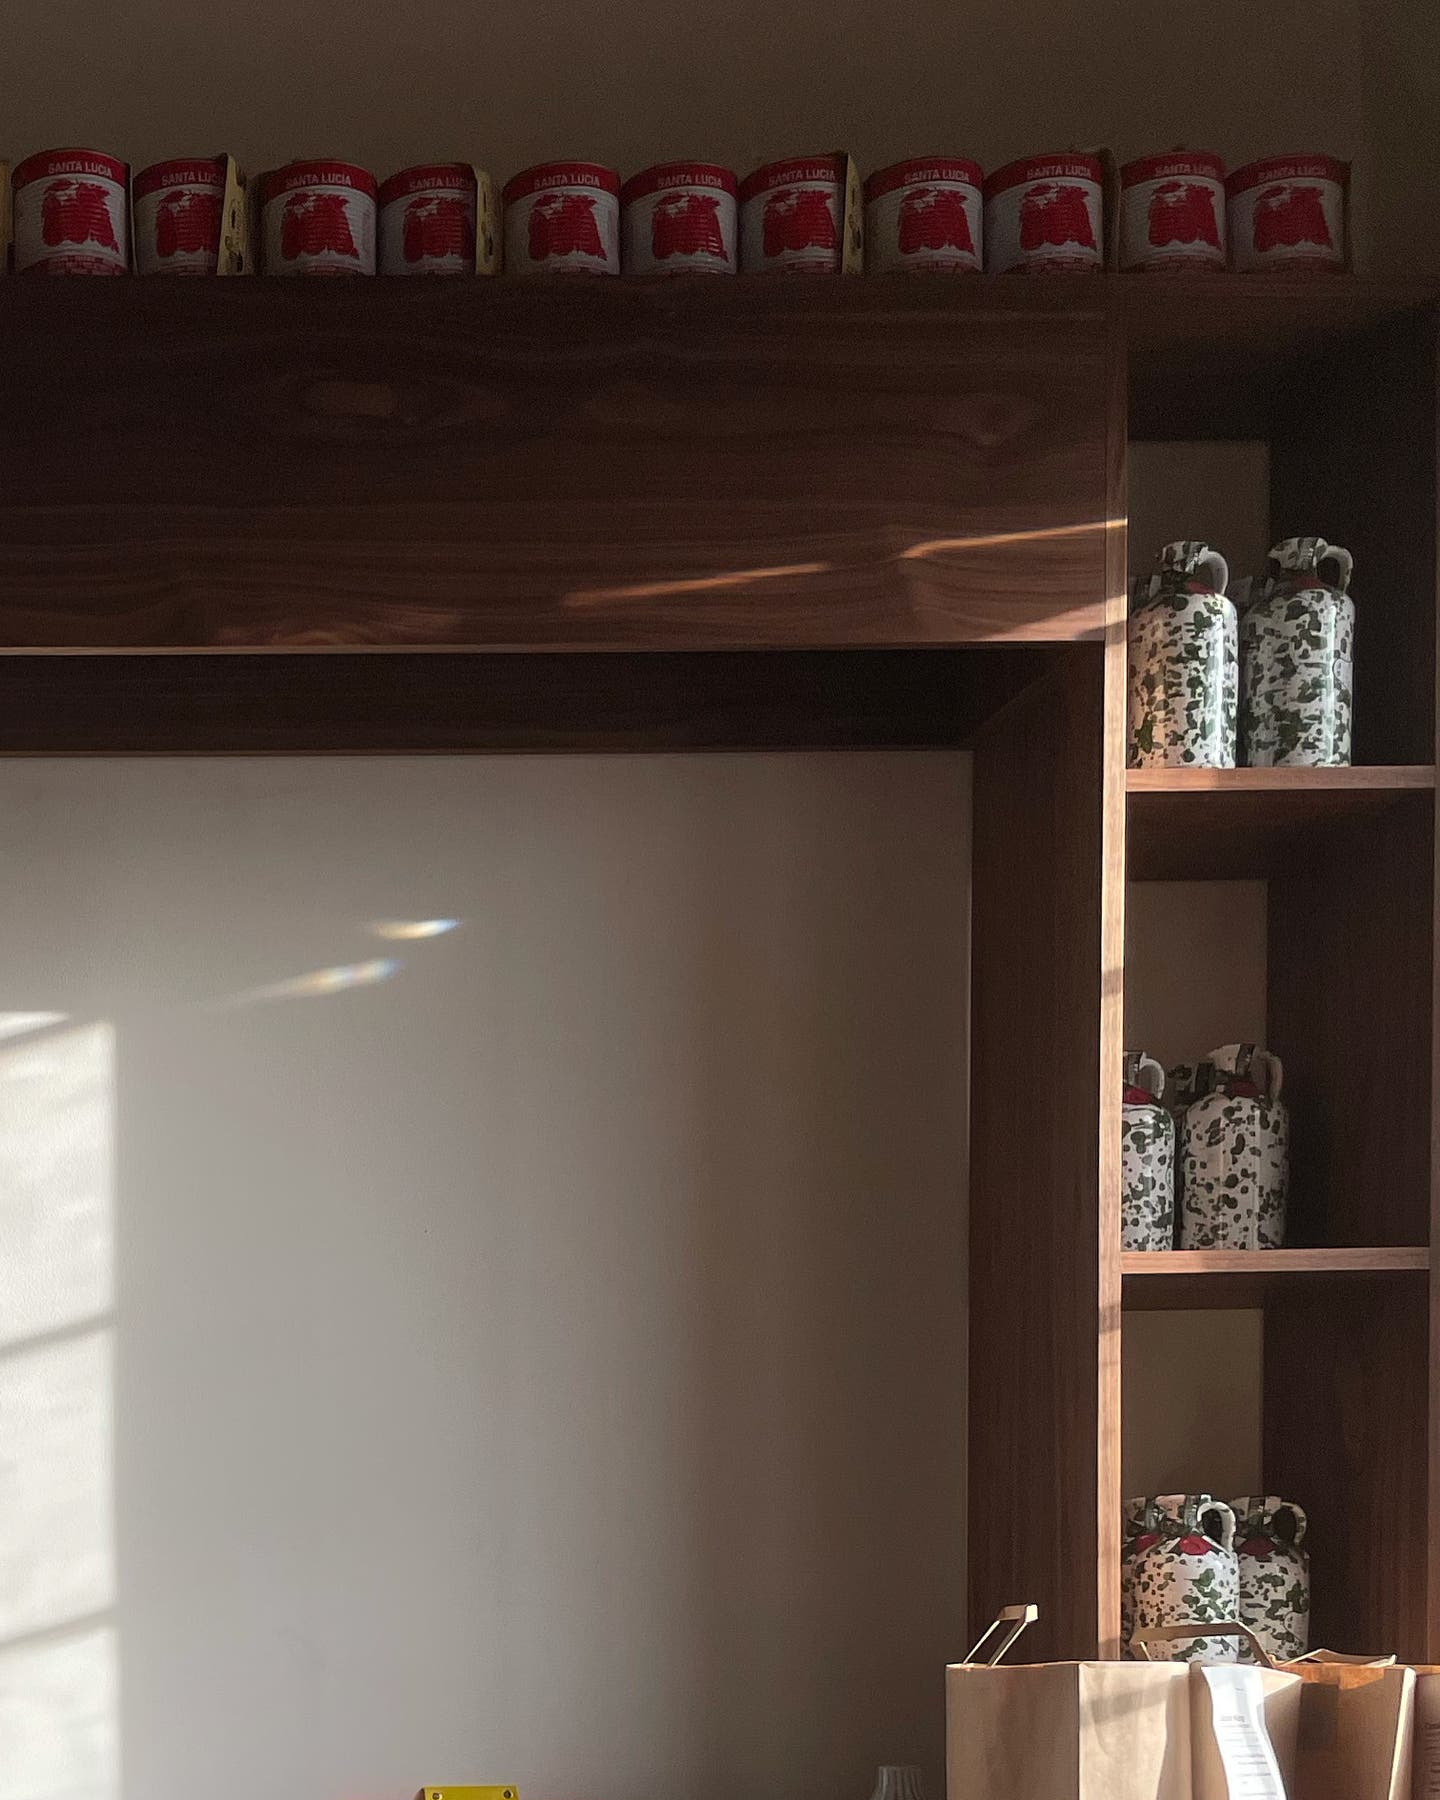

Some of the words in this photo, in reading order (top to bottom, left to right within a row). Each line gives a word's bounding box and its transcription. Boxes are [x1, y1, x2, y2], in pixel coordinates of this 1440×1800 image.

[48, 162, 82, 174] SANTA
[85, 163, 113, 178] LUCIA
[769, 171, 803, 184] SANTA
[806, 169, 836, 181] LUCIA
[904, 170, 940, 183] SANTA
[942, 169, 970, 182] LUCIA
[1027, 168, 1062, 179] SANTA
[1064, 166, 1092, 179] LUCIA
[1155, 164, 1190, 177] SANTA
[161, 171, 195, 186] SANTA
[285, 174, 318, 189] SANTA
[321, 173, 352, 186] LUCIA
[534, 175, 568, 190] SANTA
[571, 174, 601, 187] LUCIA
[657, 175, 692, 188] SANTA
[695, 175, 723, 188] LUCIA
